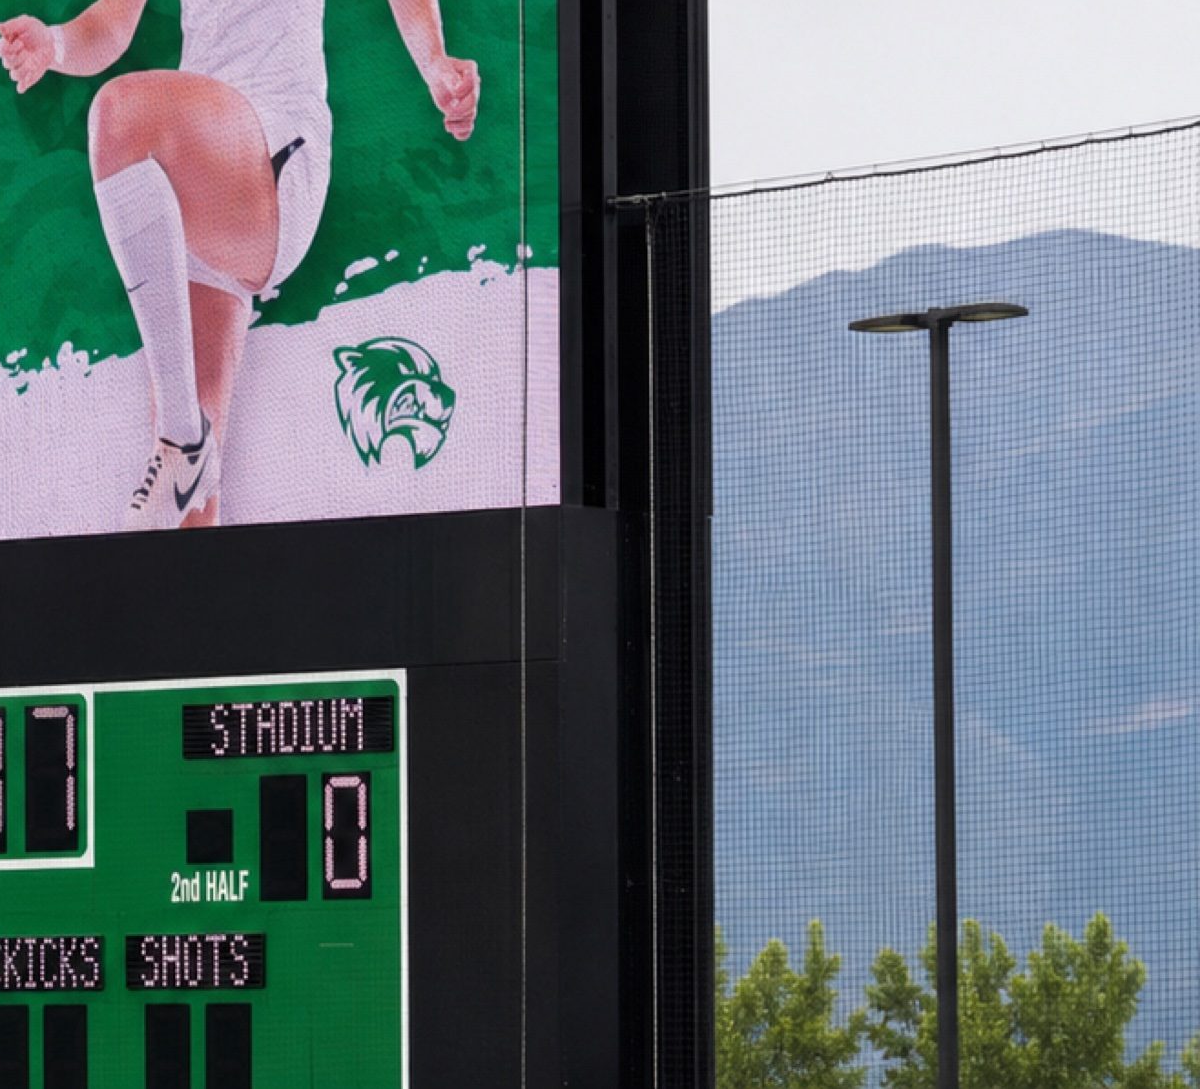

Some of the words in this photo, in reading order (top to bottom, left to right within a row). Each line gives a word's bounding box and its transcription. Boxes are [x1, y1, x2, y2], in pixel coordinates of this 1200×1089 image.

[210, 698, 363, 755] STADIUM
[324, 776, 367, 890] 0
[171, 873, 200, 903] 2nd
[206, 870, 249, 902] HALF
[141, 935, 249, 987] SHOTS
